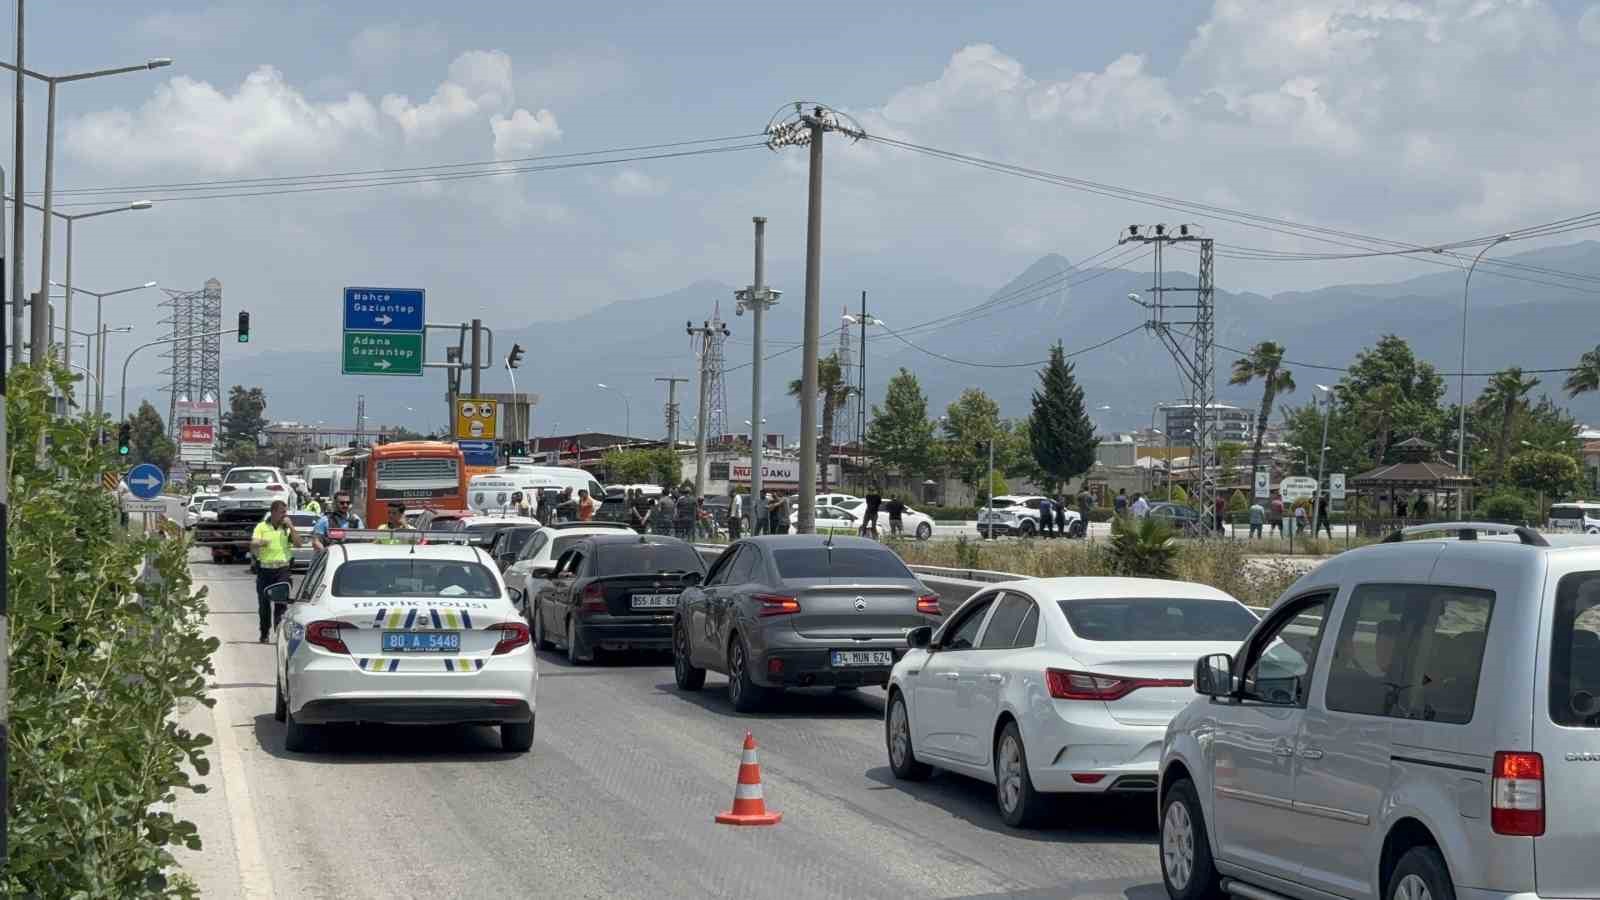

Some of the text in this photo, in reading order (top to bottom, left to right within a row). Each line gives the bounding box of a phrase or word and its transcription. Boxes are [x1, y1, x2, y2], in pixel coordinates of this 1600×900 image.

[353, 303, 415, 315] Gaziantep
[353, 336, 391, 345] Adana
[352, 346, 414, 359] Gaziantep
[390, 634, 458, 648] 80 A 5448
[873, 652, 890, 662] 624
